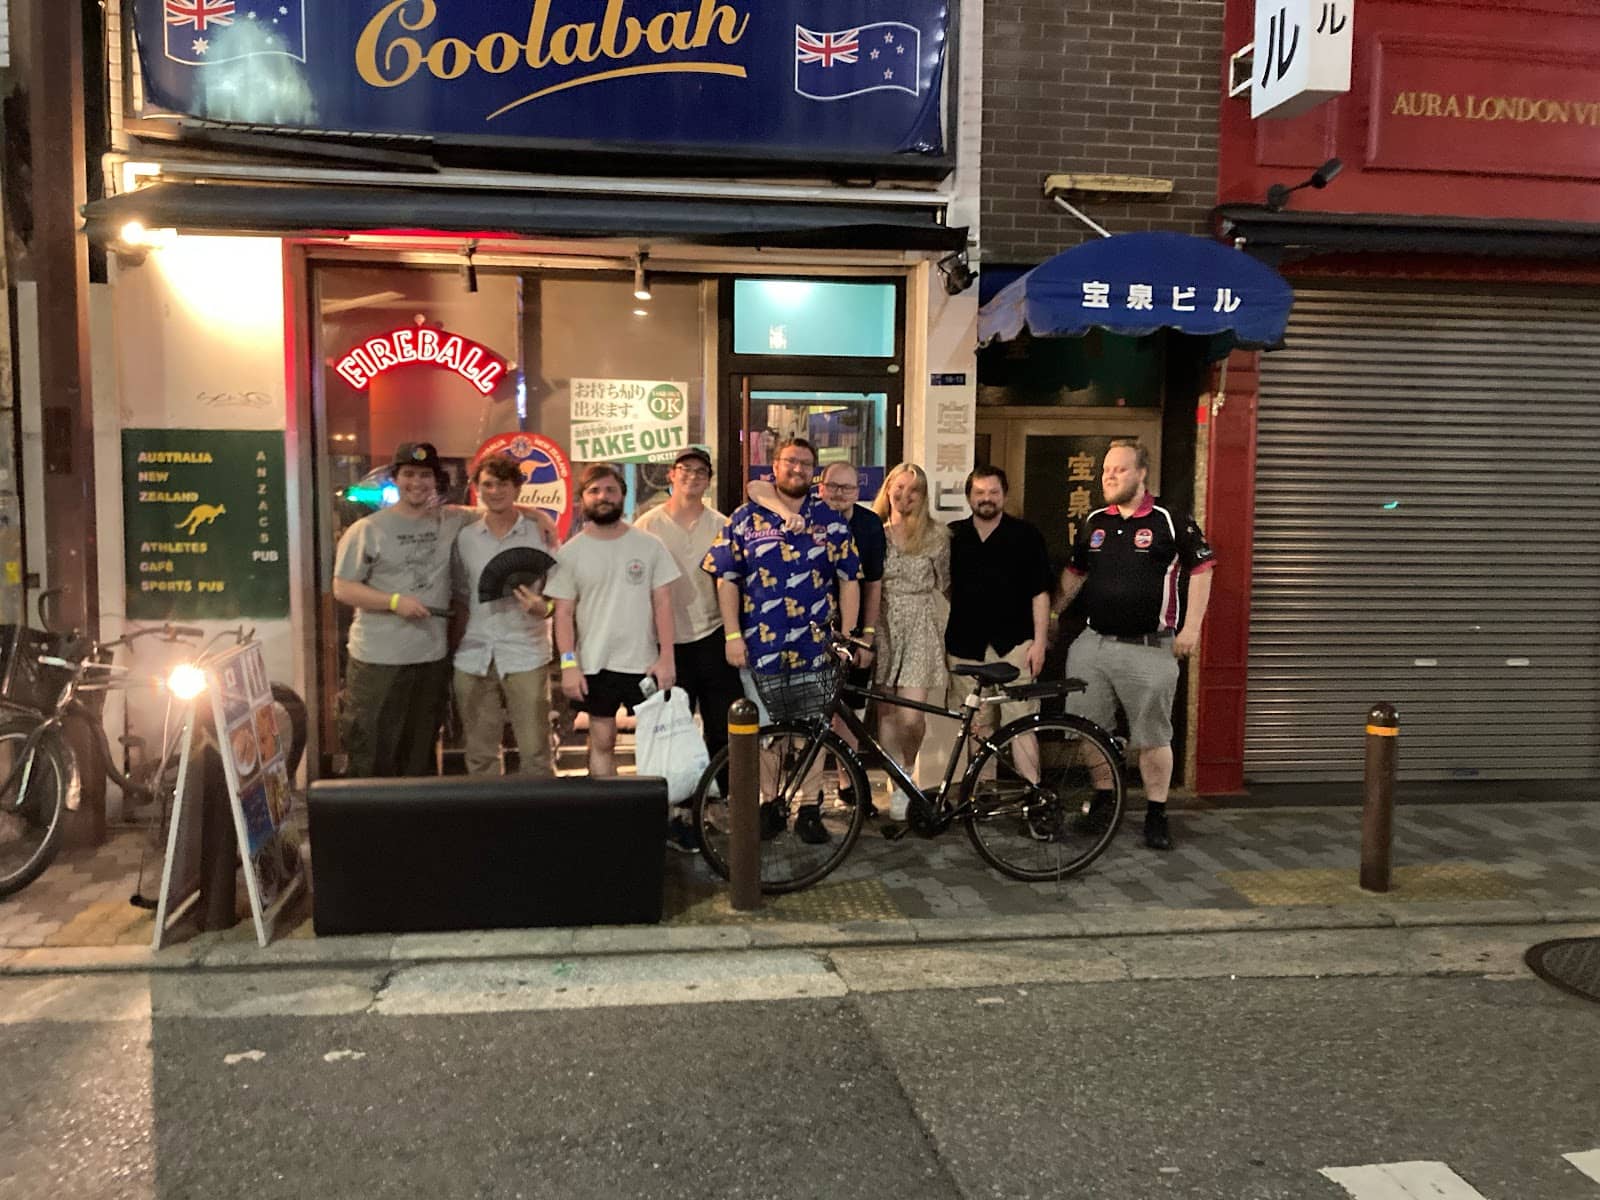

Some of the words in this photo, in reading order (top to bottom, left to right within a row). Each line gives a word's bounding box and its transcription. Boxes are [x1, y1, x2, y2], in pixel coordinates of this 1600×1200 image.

[1316, 3, 1346, 35] ル
[355, 0, 750, 88] Coolabah
[1261, 8, 1300, 88] ル
[1391, 91, 1461, 118] AURA
[1465, 95, 1569, 123] LONDON
[1081, 281, 1242, 313] 宝泉ビル
[336, 329, 502, 394] FIREBALL
[575, 383, 645, 401] お持ち帰り
[650, 397, 682, 414] OK
[576, 432, 637, 460] TAKE
[640, 426, 683, 451] OUT
[137, 451, 213, 464] AUSTRALIA
[137, 471, 170, 483] NEW
[138, 491, 200, 503] ZEALAND
[140, 541, 208, 553] ATHLETES
[252, 550, 279, 562] PUB
[141, 580, 192, 592] SPORTS
[198, 580, 225, 592] PUB
